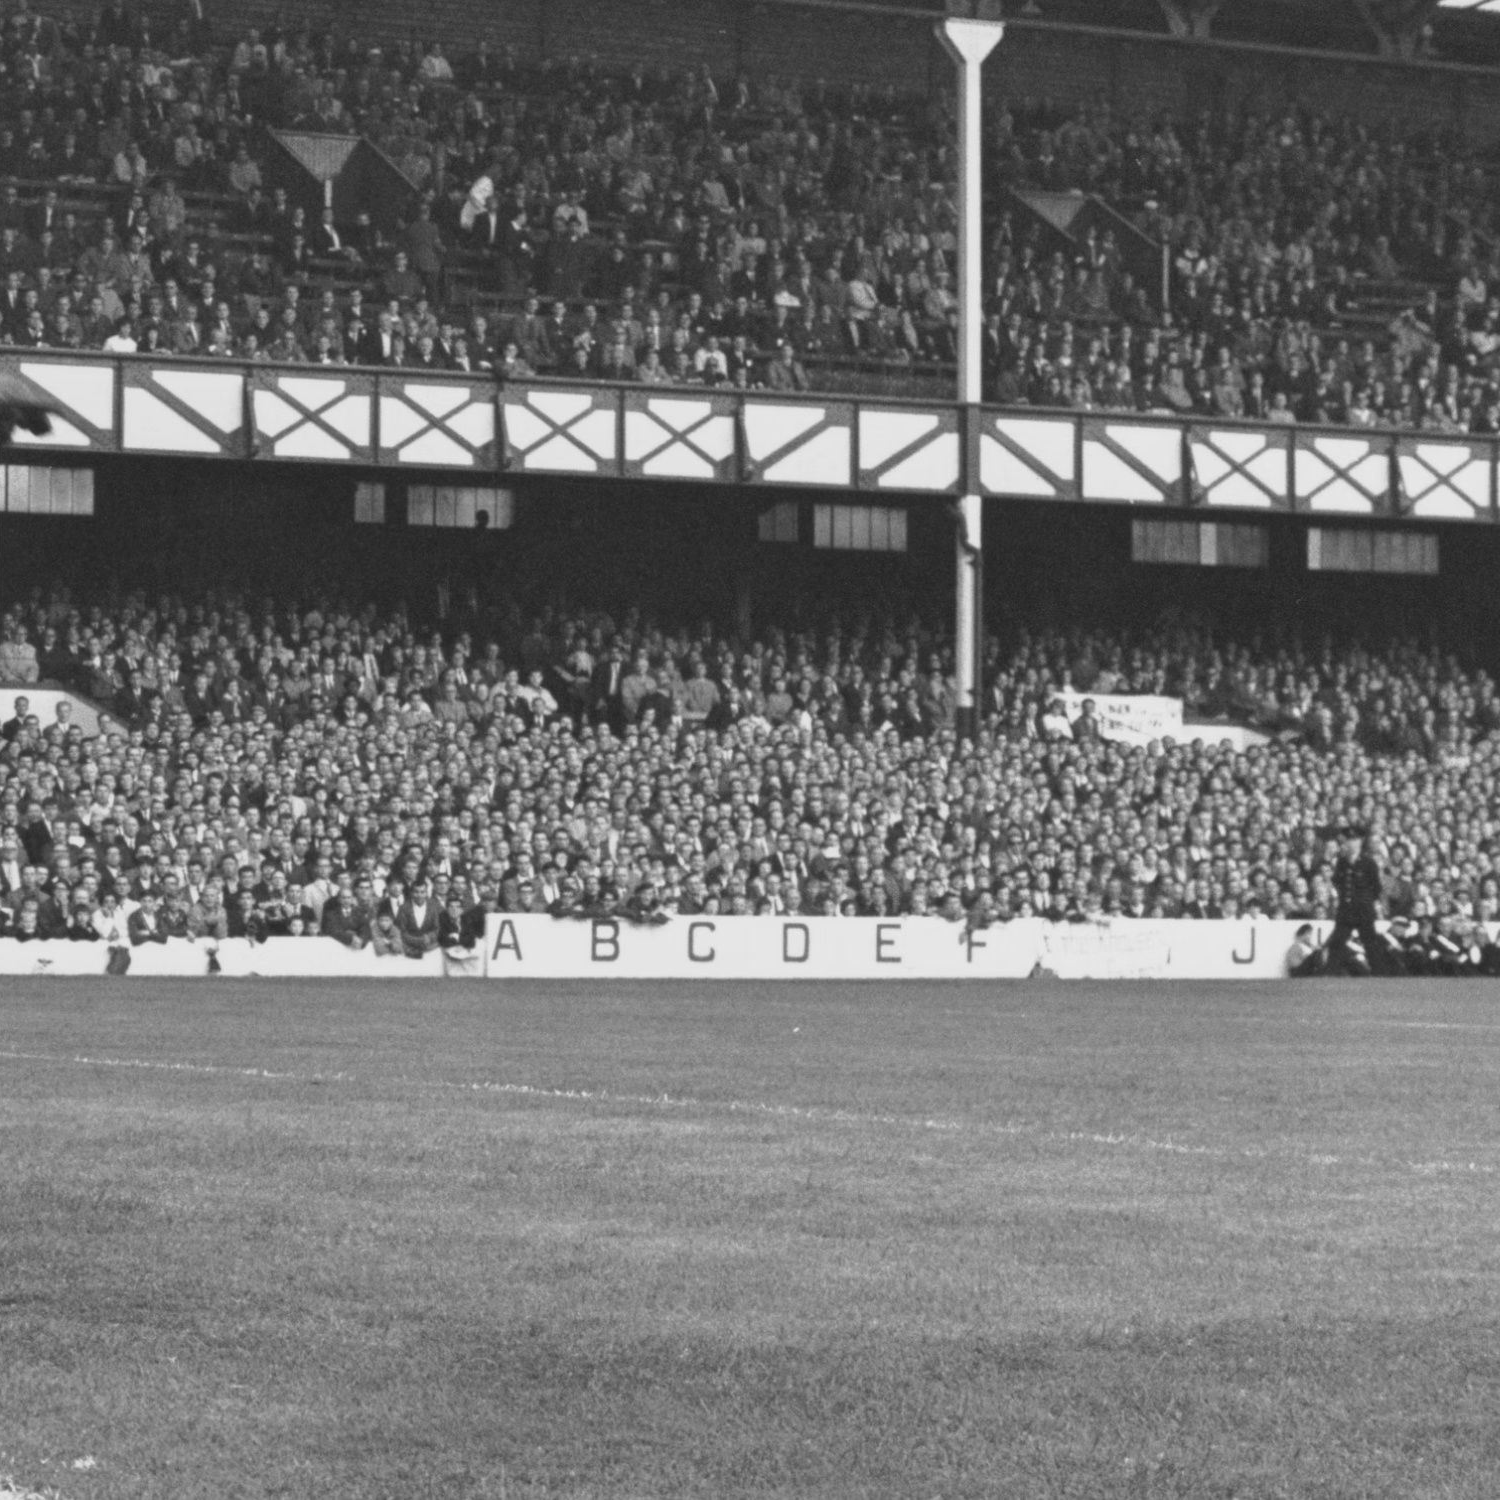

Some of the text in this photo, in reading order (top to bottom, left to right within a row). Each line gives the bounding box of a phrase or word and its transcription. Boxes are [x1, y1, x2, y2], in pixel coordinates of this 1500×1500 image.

[492, 919, 522, 960] A
[591, 919, 620, 961] B
[688, 922, 715, 962] C
[783, 923, 809, 962] D
[876, 924, 902, 962] E
[1232, 927, 1255, 963] J
